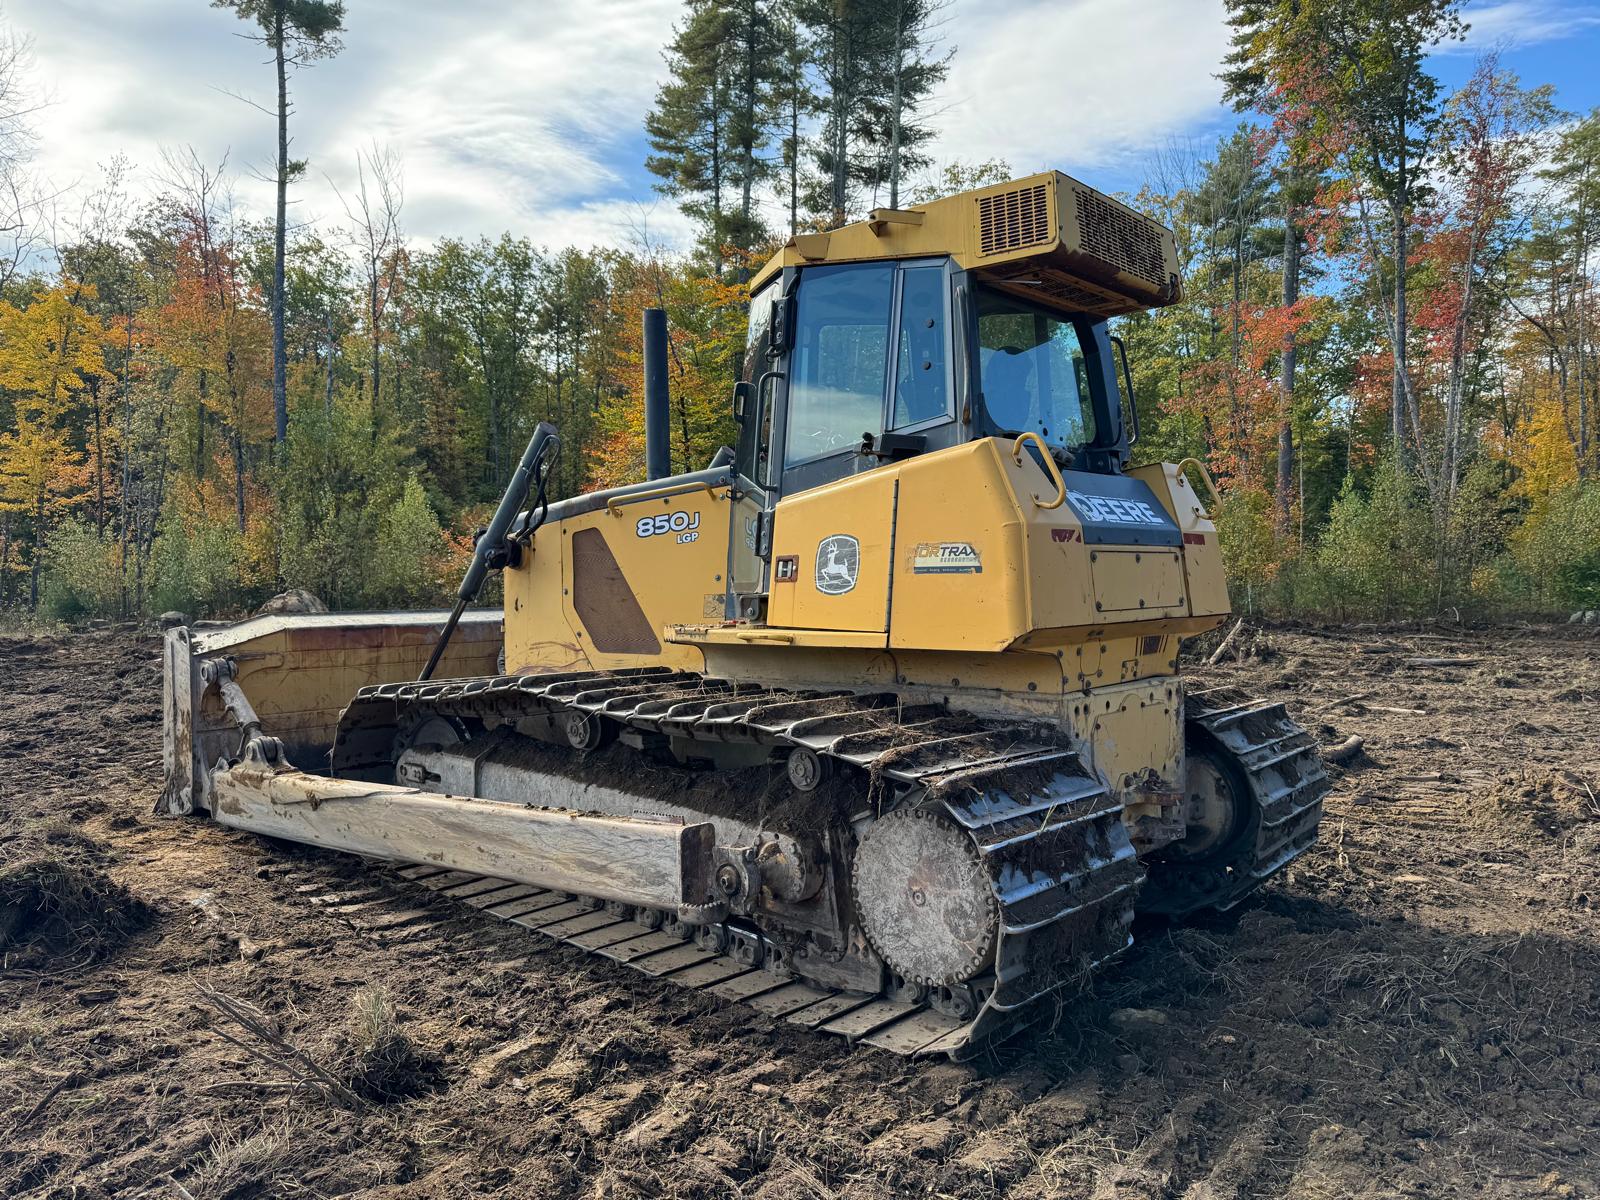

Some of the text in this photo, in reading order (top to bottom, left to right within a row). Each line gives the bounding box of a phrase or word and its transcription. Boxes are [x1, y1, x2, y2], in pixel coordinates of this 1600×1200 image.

[1066, 490, 1164, 523] DEERE
[637, 511, 700, 538] 850J
[676, 532, 699, 544] LGP
